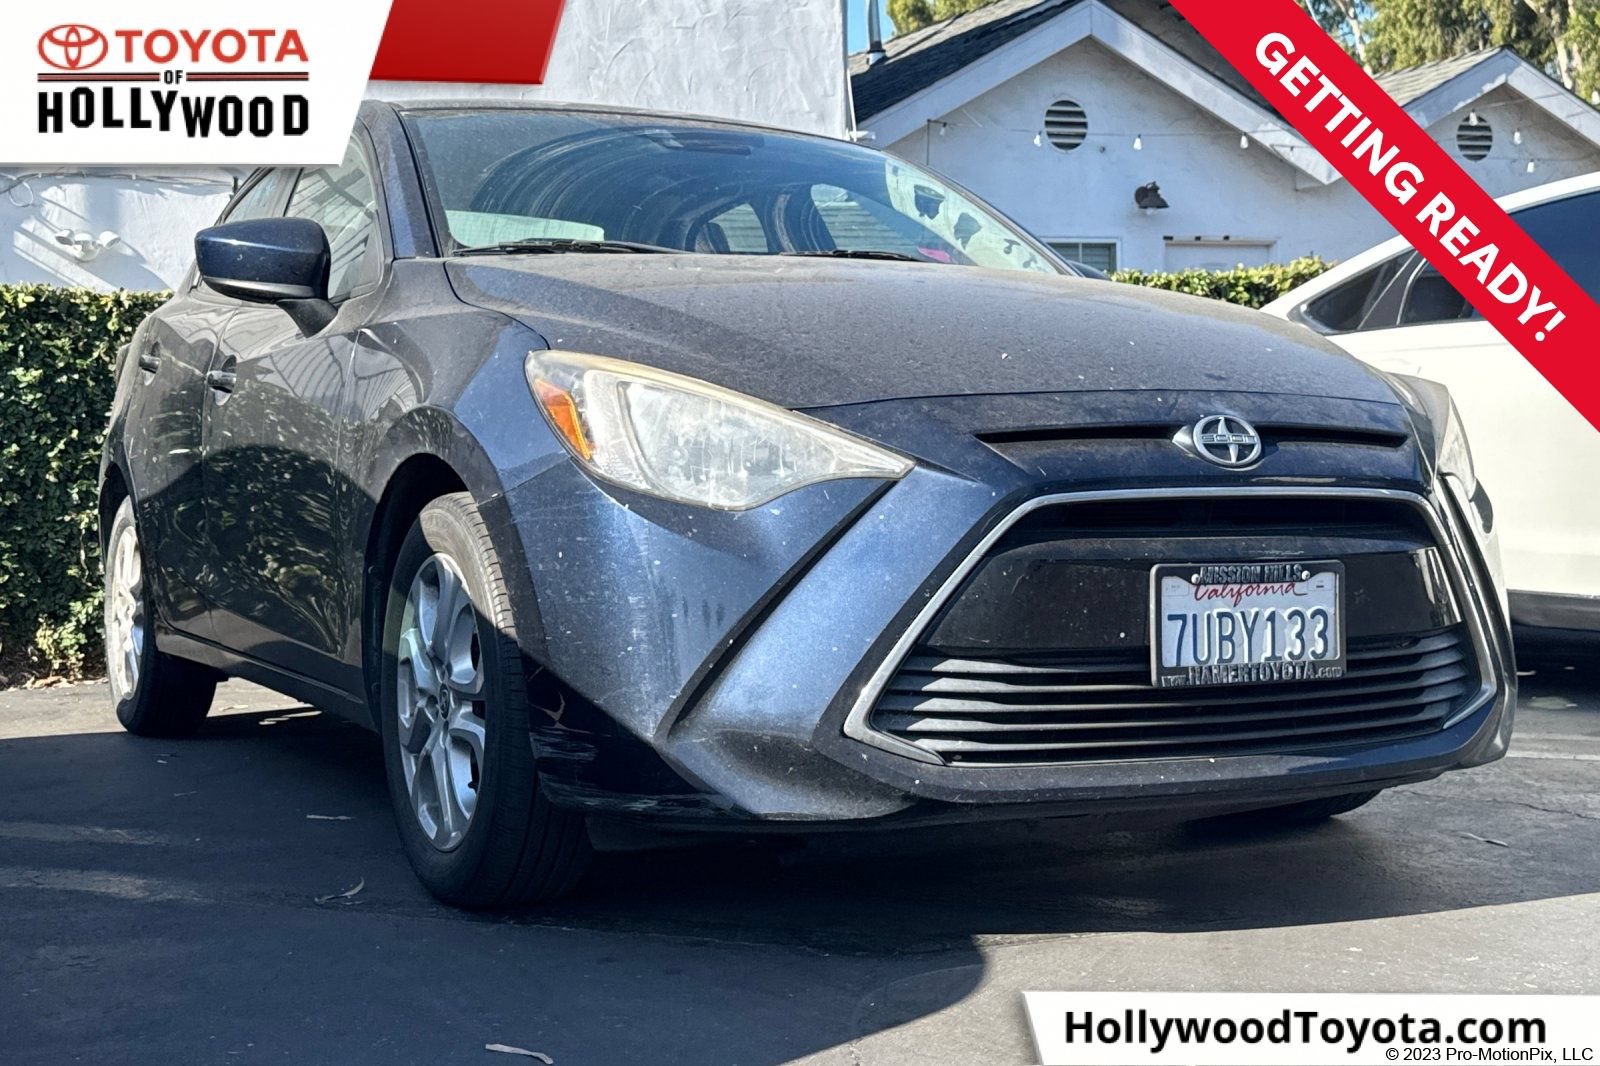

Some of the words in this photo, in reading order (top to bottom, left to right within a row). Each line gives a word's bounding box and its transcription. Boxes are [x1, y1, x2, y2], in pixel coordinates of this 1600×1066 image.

[1200, 565, 1261, 584] MISSION
[1264, 564, 1302, 582] HILLS
[1194, 582, 1308, 607] California
[1167, 608, 1329, 666] 7UBY133
